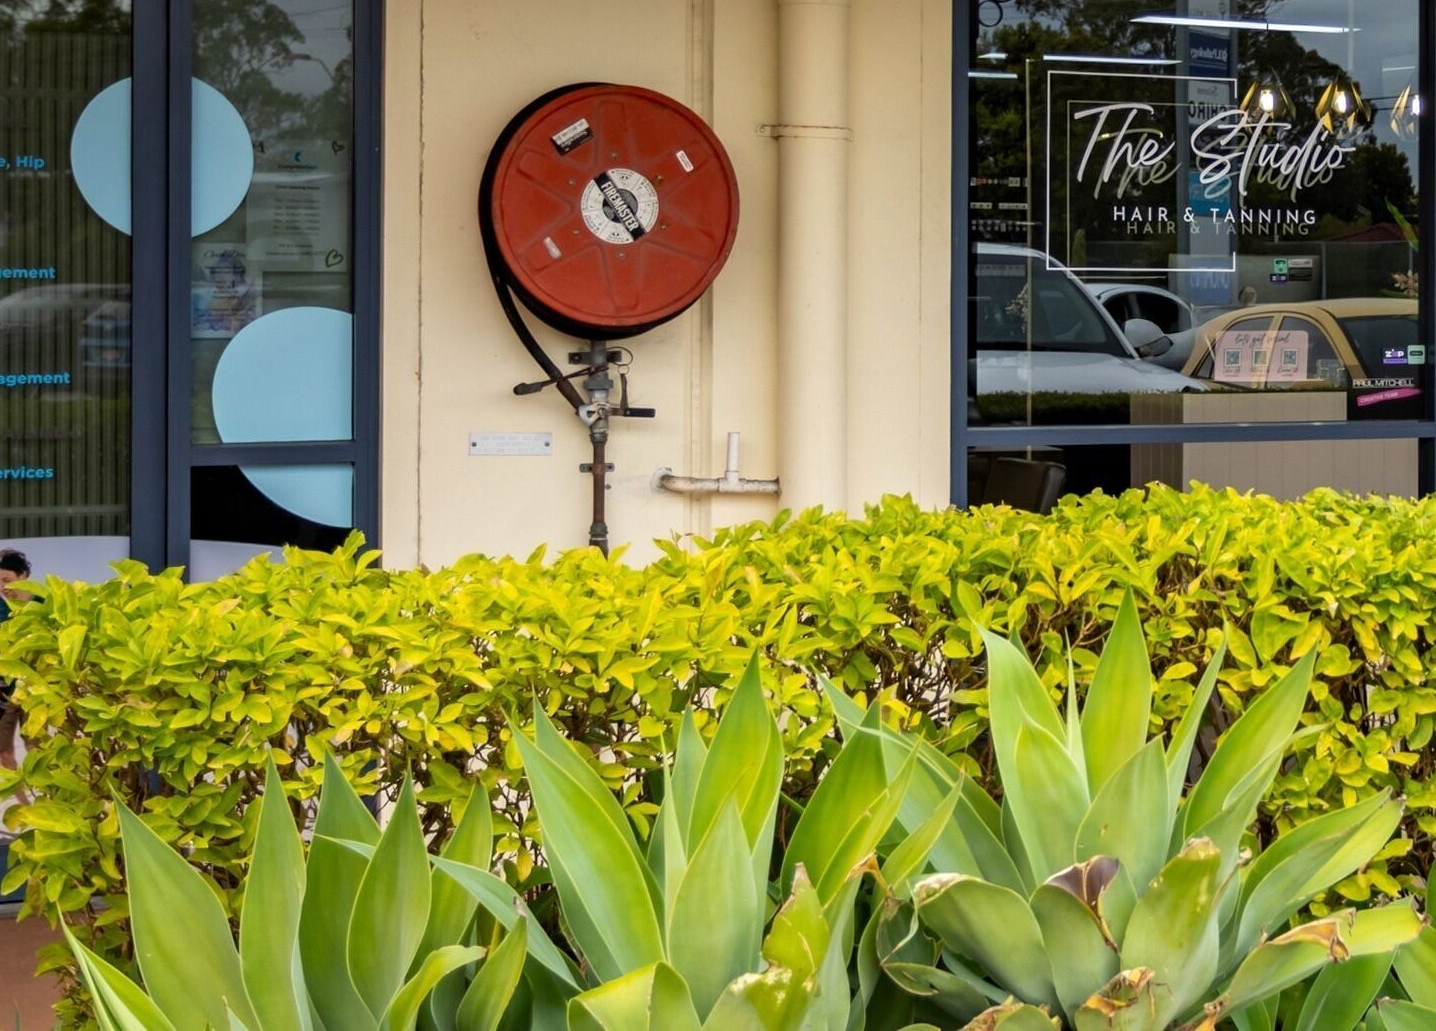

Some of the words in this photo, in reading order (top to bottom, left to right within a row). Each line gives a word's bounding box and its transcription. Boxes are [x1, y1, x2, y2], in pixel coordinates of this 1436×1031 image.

[1073, 102, 1176, 183] The
[1190, 108, 1356, 197] Studio
[16, 155, 45, 170] Hip
[600, 180, 640, 232] FIREMASTER
[1113, 206, 1168, 222] HAIR
[1183, 206, 1196, 222] &
[1210, 208, 1317, 225] TANNING
[0, 266, 56, 279] ement
